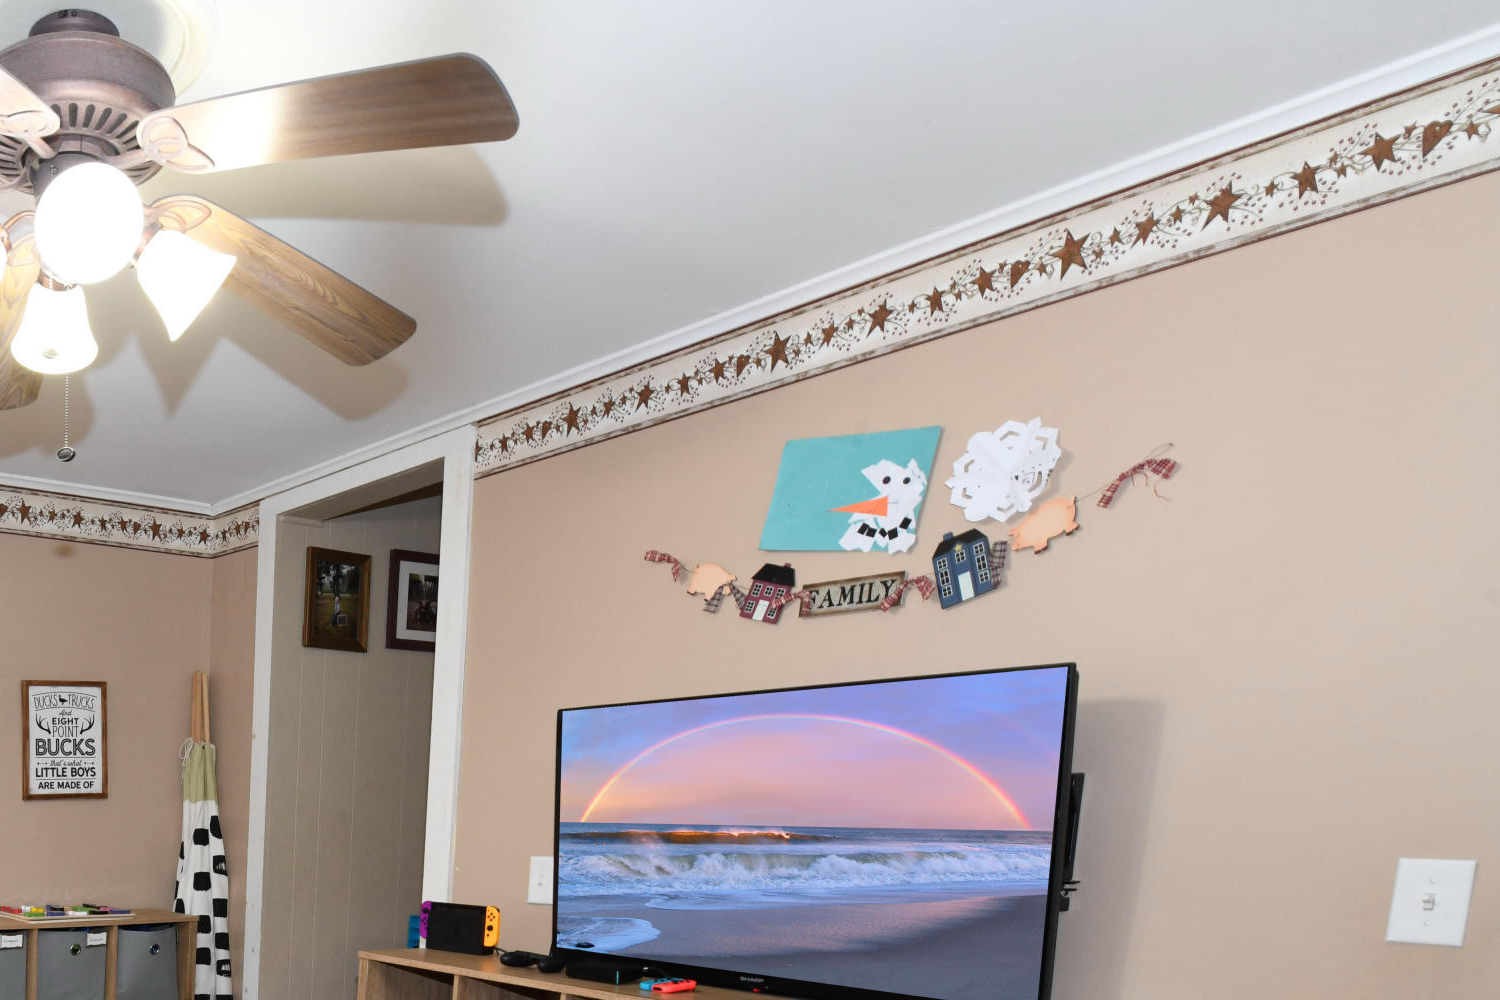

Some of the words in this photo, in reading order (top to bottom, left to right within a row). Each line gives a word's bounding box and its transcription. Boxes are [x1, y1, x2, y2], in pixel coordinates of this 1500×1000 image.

[33, 694, 58, 709] DUCKS
[68, 693, 94, 709] TRUCKS
[52, 717, 79, 725] EIGHT
[52, 726, 79, 737] POINT
[35, 738, 96, 756] BUCKS
[50, 759, 66, 767] that's
[67, 759, 82, 767] what
[35, 767, 67, 778] LITTLE
[70, 767, 96, 777] BOYS
[38, 781, 55, 789] ARE
[57, 781, 81, 789] MADE
[83, 780, 94, 789] OF
